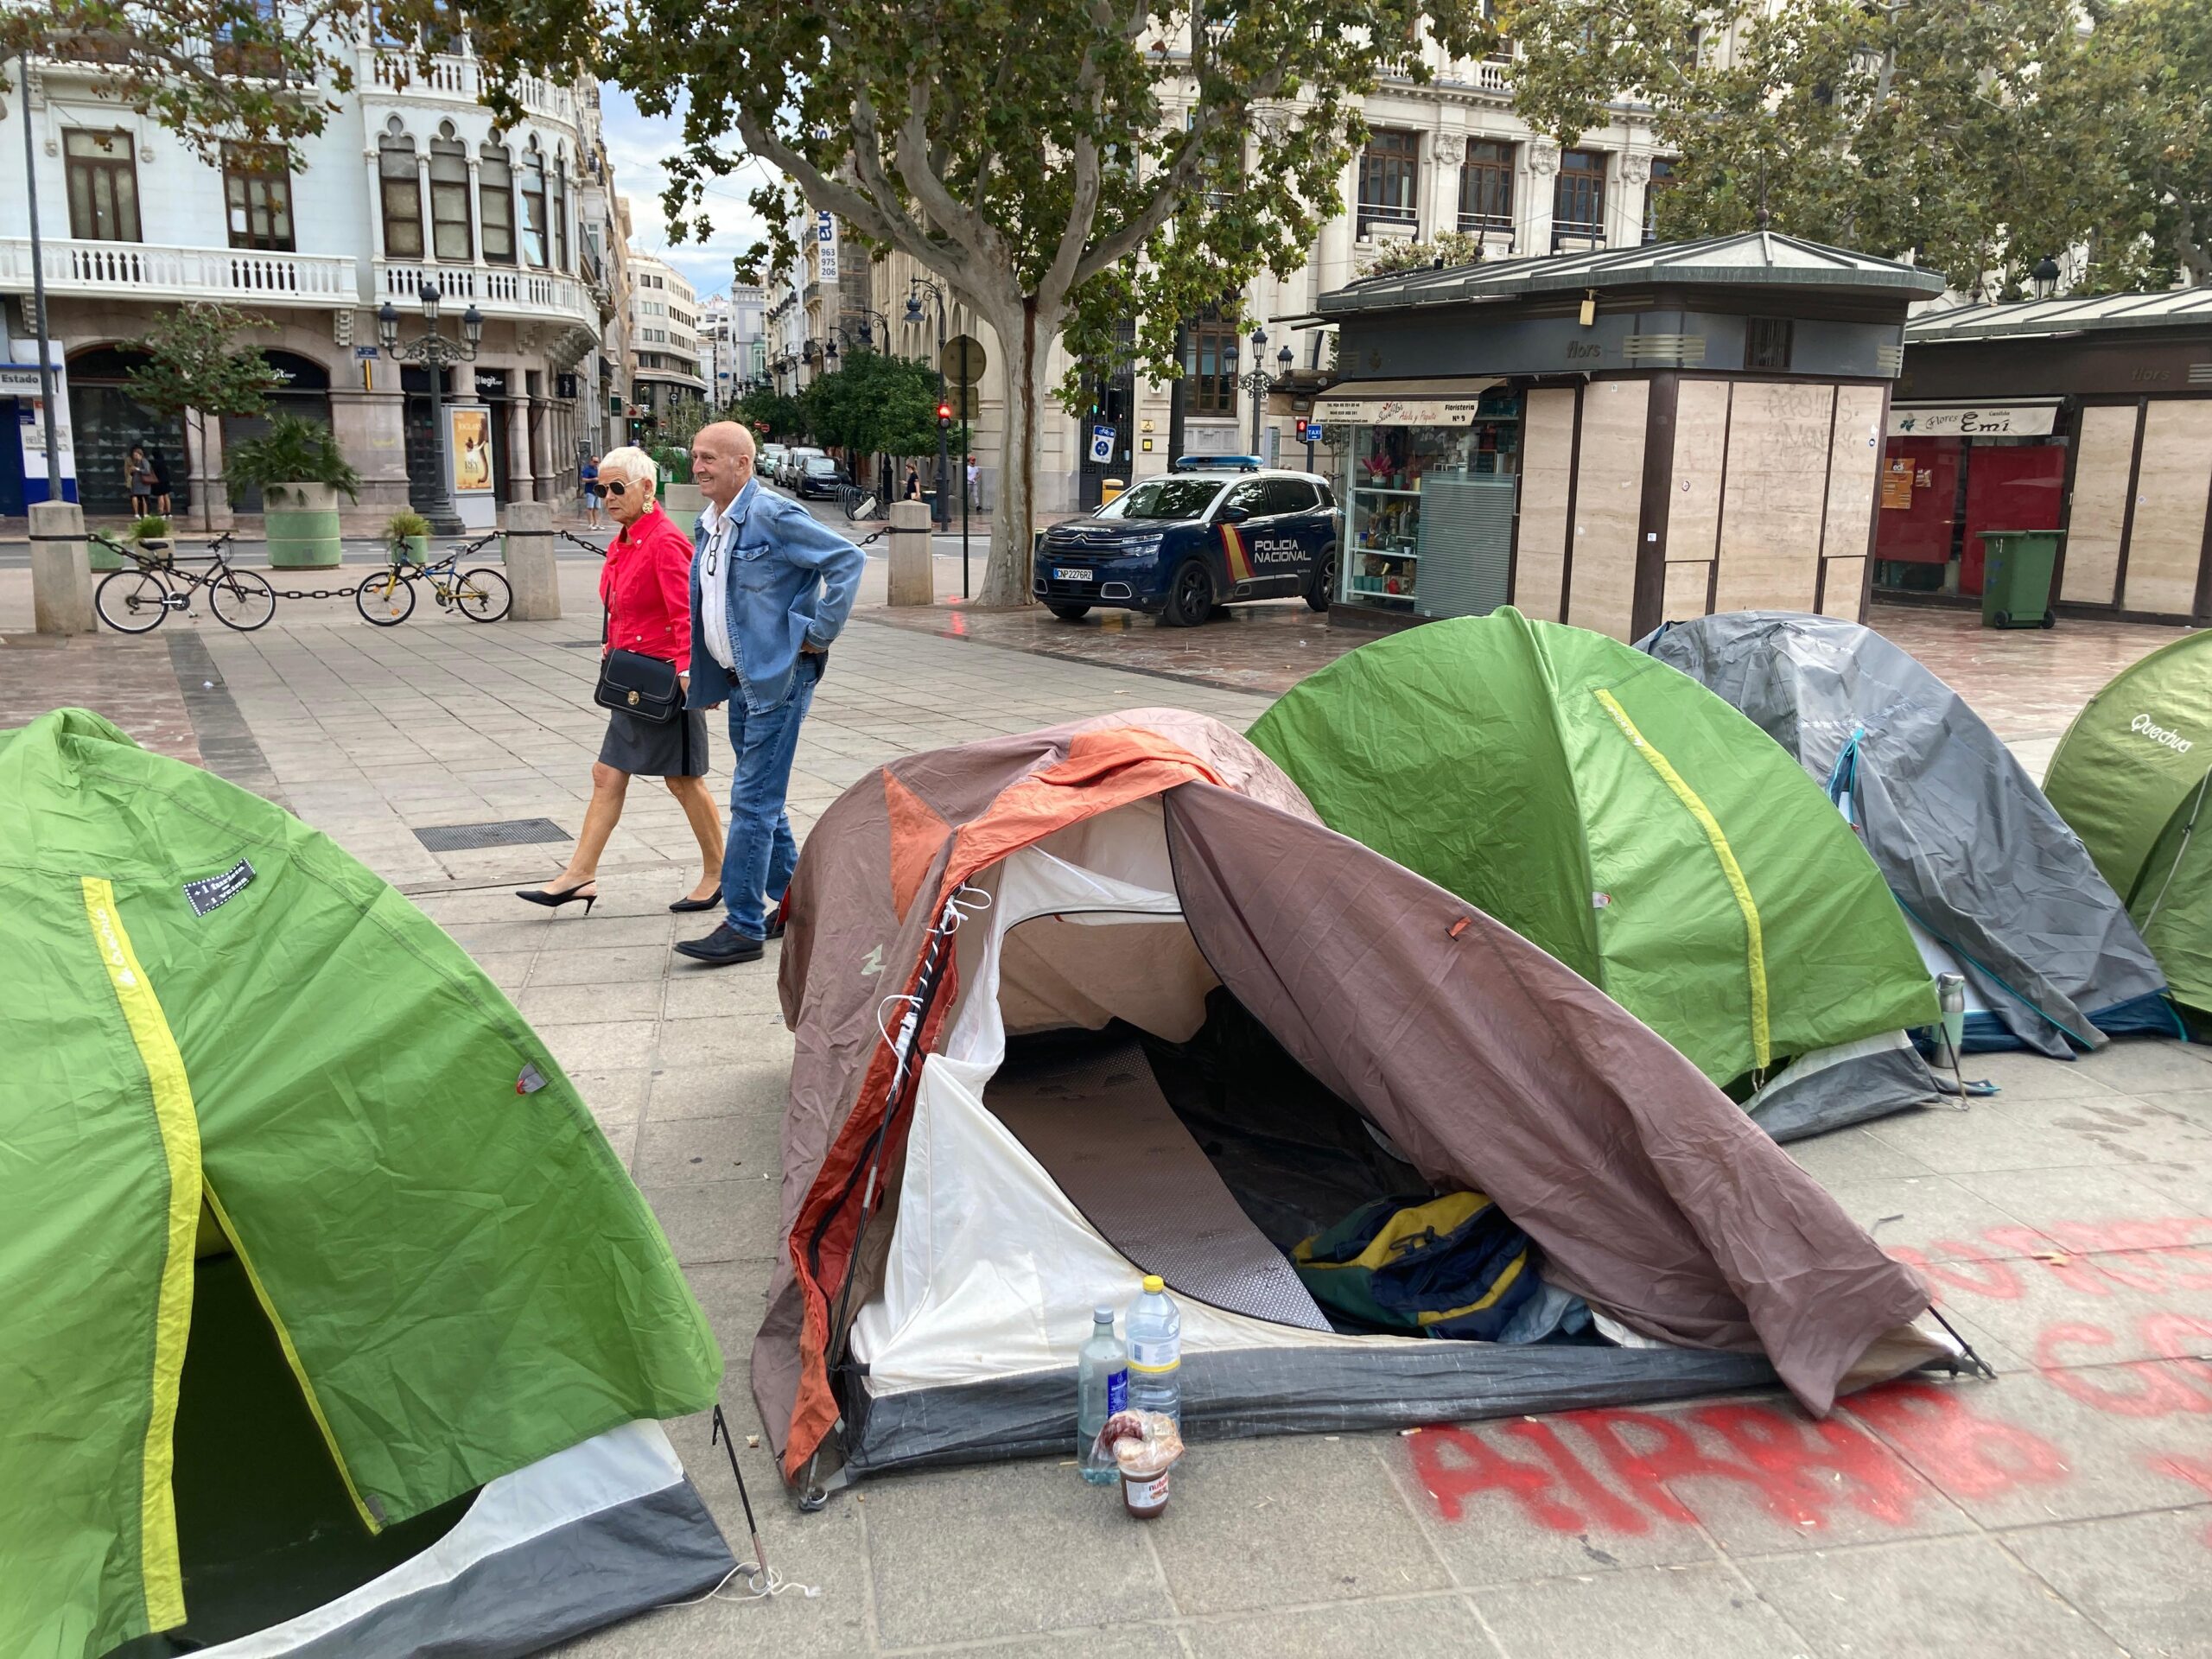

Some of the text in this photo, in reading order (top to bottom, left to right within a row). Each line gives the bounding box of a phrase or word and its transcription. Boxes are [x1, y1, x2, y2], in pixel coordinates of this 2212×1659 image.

[821, 248, 836, 257] 963
[821, 257, 836, 266] 975
[822, 267, 836, 276] 206
[2, 373, 39, 384] Estado
[1926, 414, 1958, 430] Flores
[1255, 550, 1312, 563] NACIONAL
[2131, 713, 2194, 753] Quechua
